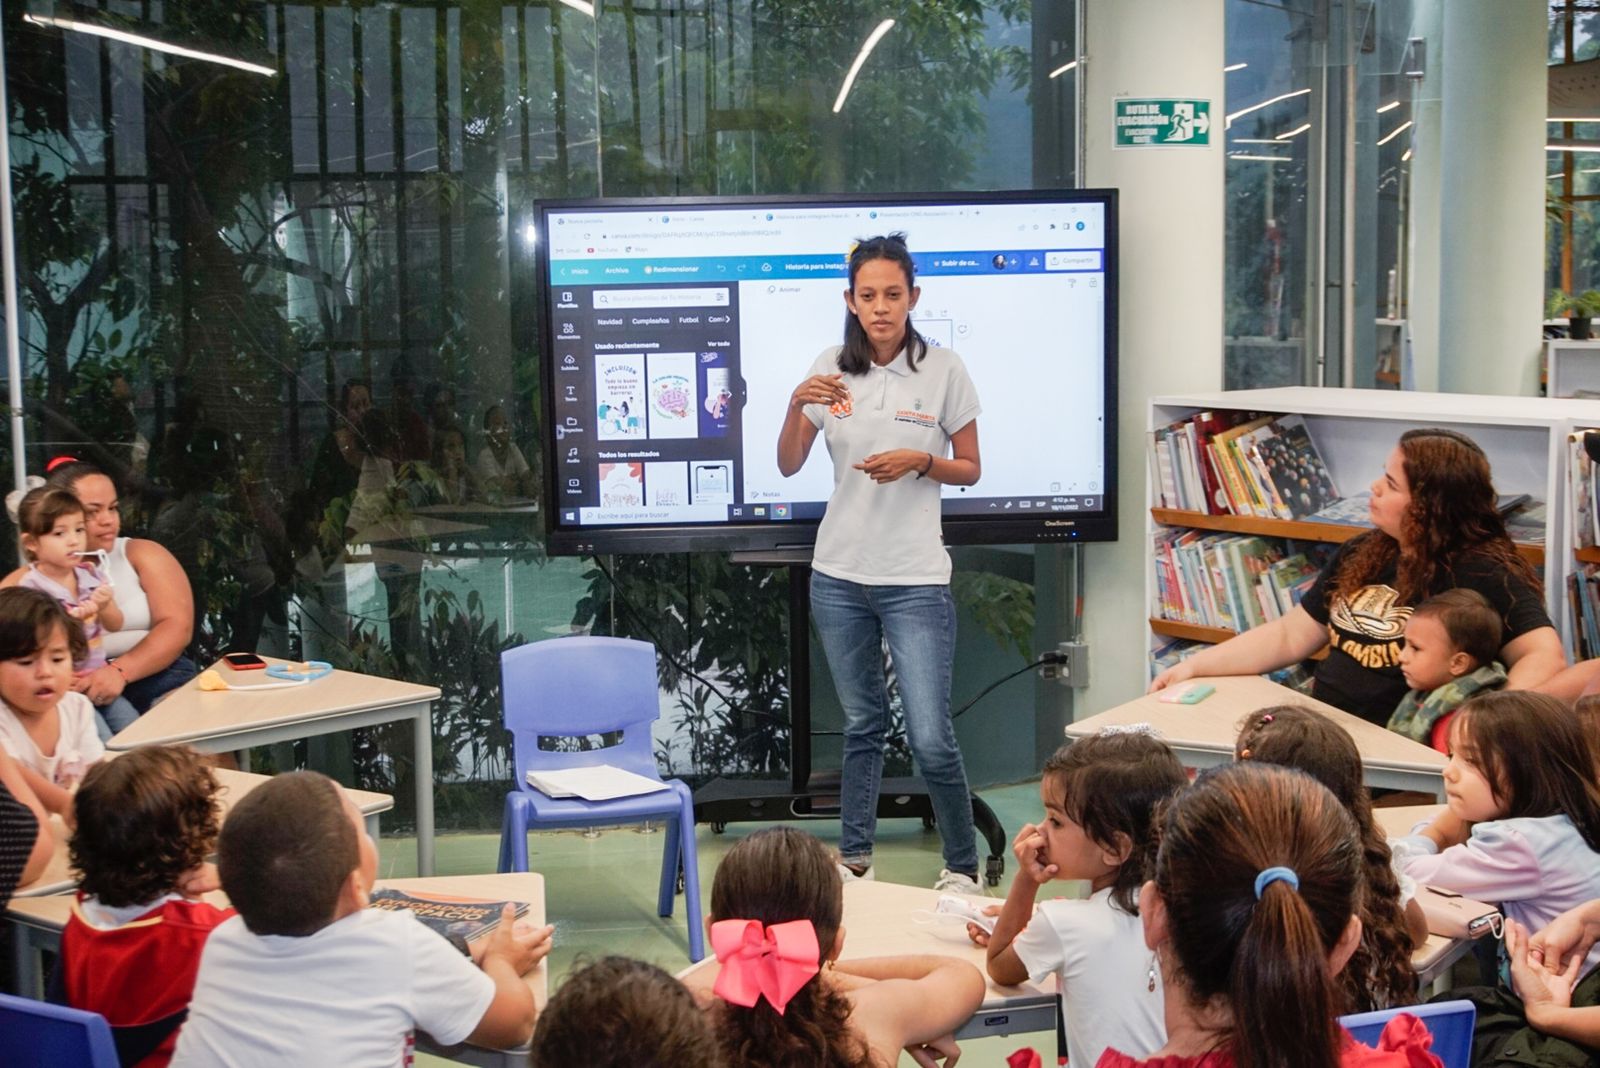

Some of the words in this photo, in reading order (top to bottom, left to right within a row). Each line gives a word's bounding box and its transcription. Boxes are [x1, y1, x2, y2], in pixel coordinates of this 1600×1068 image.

[1126, 104, 1148, 115] RUTA
[1148, 104, 1161, 114] DE
[785, 263, 810, 271] Historia
[810, 264, 824, 272] para
[597, 318, 623, 326] Navidad
[631, 317, 670, 326] Cumpleaños
[615, 341, 660, 350] recientemente
[627, 450, 660, 458] resultados
[414, 908, 483, 920] SPACIO
